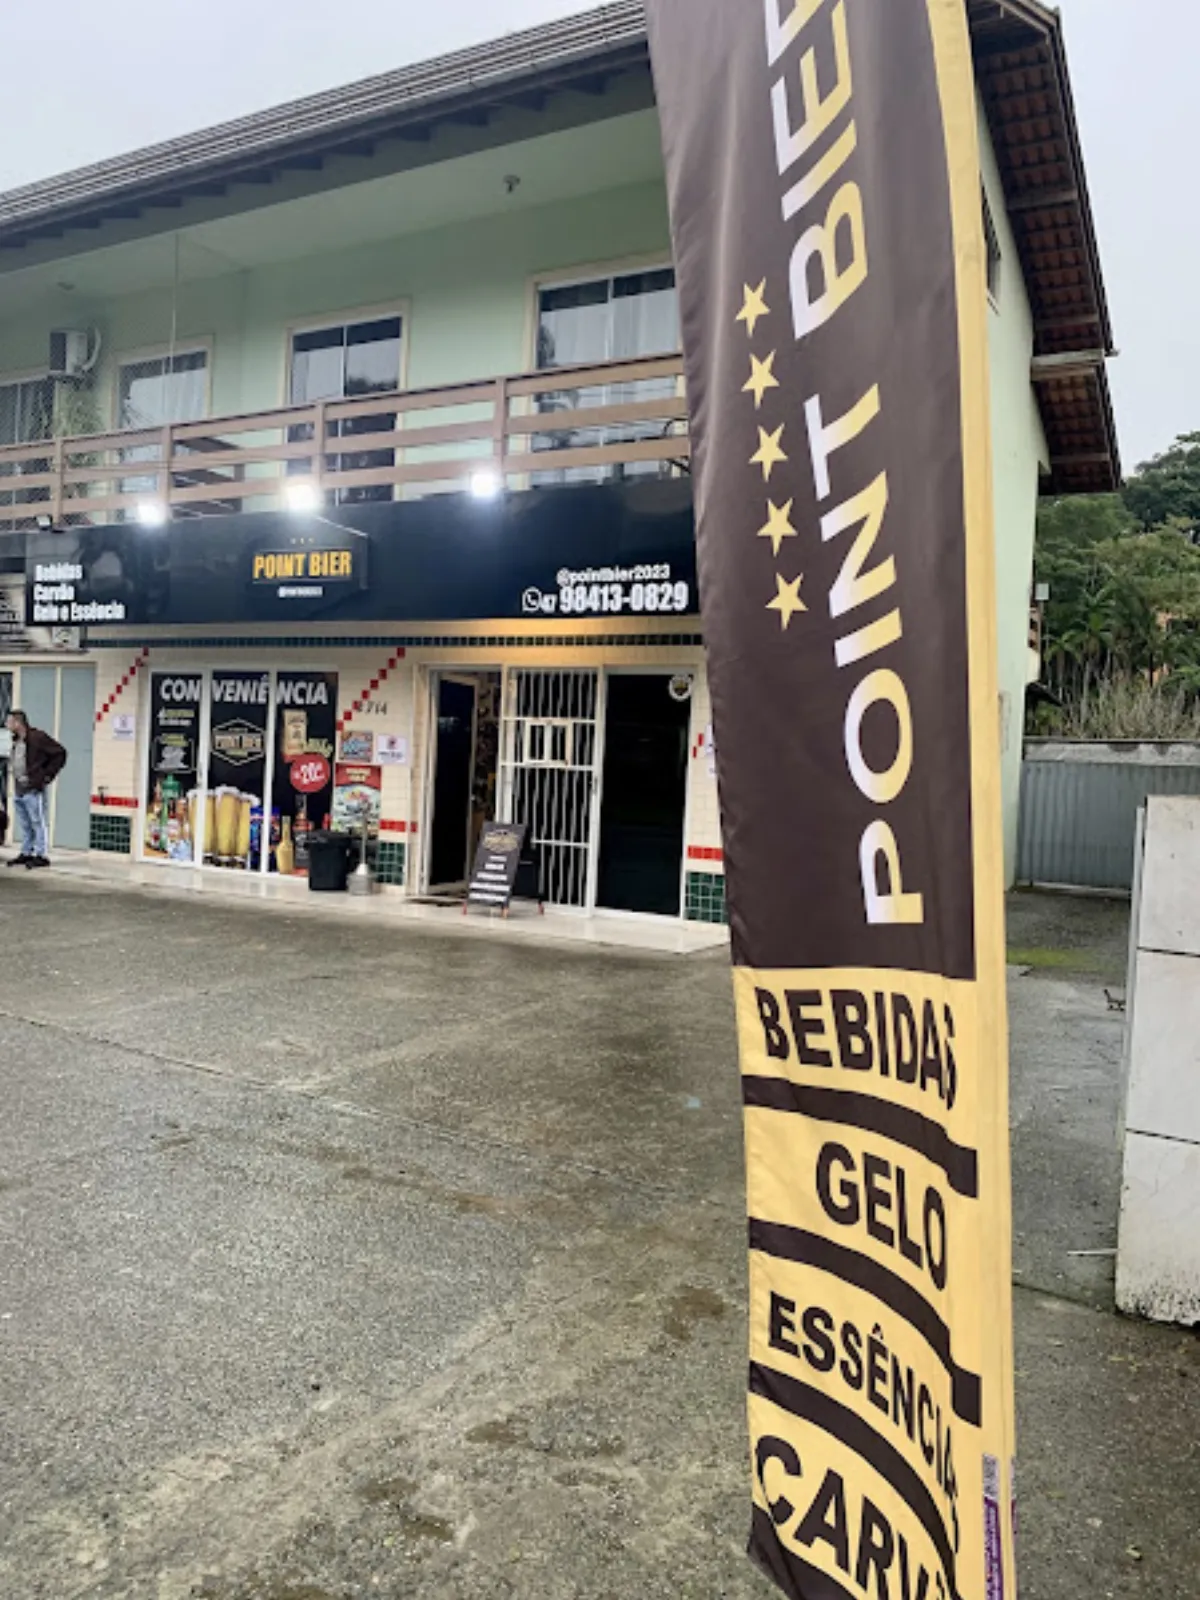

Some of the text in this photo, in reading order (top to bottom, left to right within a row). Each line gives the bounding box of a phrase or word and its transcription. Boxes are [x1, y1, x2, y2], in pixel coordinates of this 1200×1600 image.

[252, 551, 352, 579] POINT BIER
[556, 563, 671, 586] @pointbier2023
[559, 581, 689, 613] 98413-0829
[803, 381, 924, 924] POINT
[754, 986, 957, 1112] BEBIDAS
[815, 1140, 948, 1291] GELO
[754, 1435, 947, 1600] CARV
